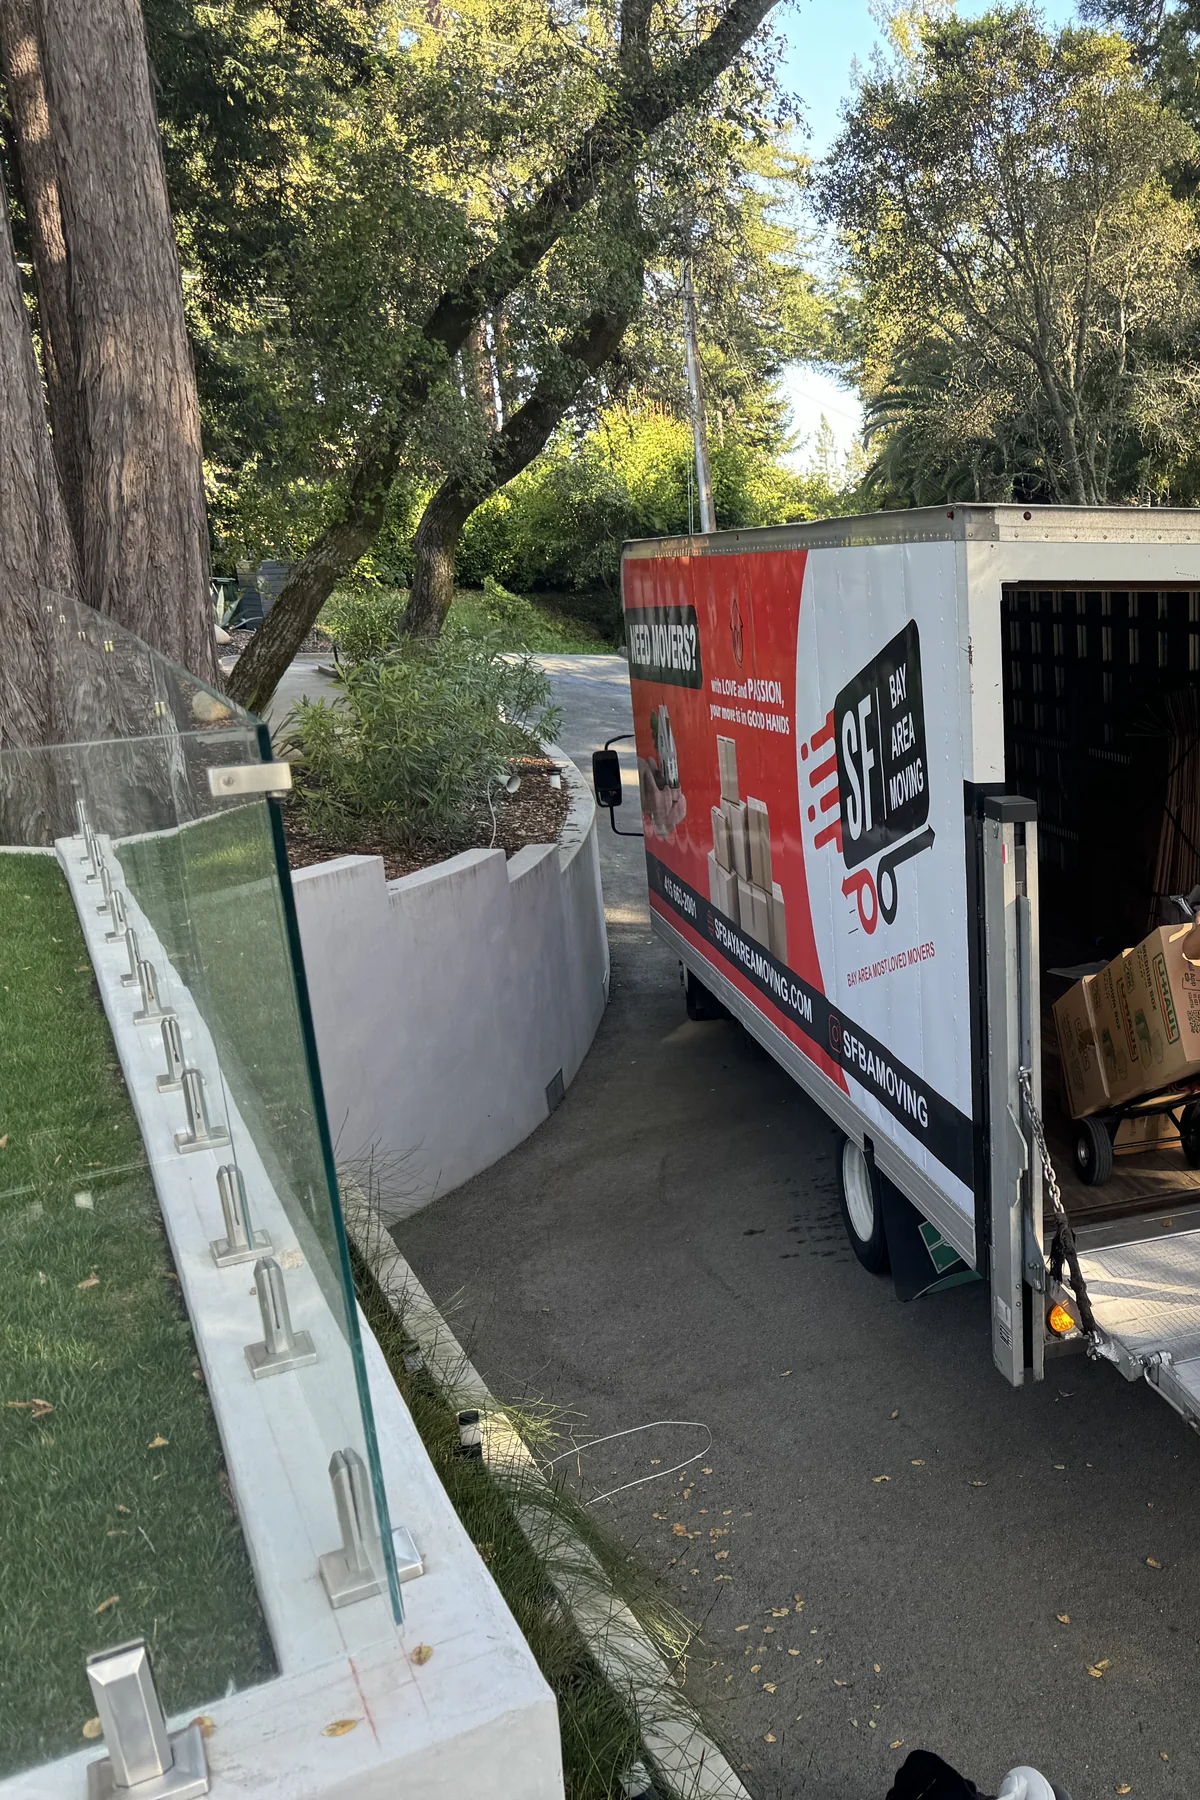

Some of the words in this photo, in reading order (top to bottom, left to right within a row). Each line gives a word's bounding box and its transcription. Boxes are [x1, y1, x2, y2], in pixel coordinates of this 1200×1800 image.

[630, 624, 651, 665] NEED
[651, 624, 697, 672] MOVERS?
[711, 677, 721, 694] with
[721, 679, 737, 697] LOVE
[737, 682, 747, 699] and
[747, 678, 784, 708] PASSION,
[888, 662, 907, 709] BAY
[710, 704, 721, 721] your
[721, 707, 735, 721] move
[735, 707, 741, 723] is
[741, 708, 747, 725] in
[747, 710, 765, 730] GOOD
[766, 713, 790, 735] HANDS
[891, 712, 916, 761] AREA
[842, 694, 875, 841] SF
[889, 757, 924, 811] MOVING
[714, 917, 813, 1023] SFBAYAREAMOVING.COM
[847, 971, 857, 987] BAY
[858, 966, 873, 984] AREA
[872, 960, 888, 979] MOST
[888, 952, 907, 973] LOVED
[907, 941, 935, 966] MOVERS
[1157, 959, 1175, 1037] U-HAUL
[843, 1030, 929, 1128] SFBAMOVING
